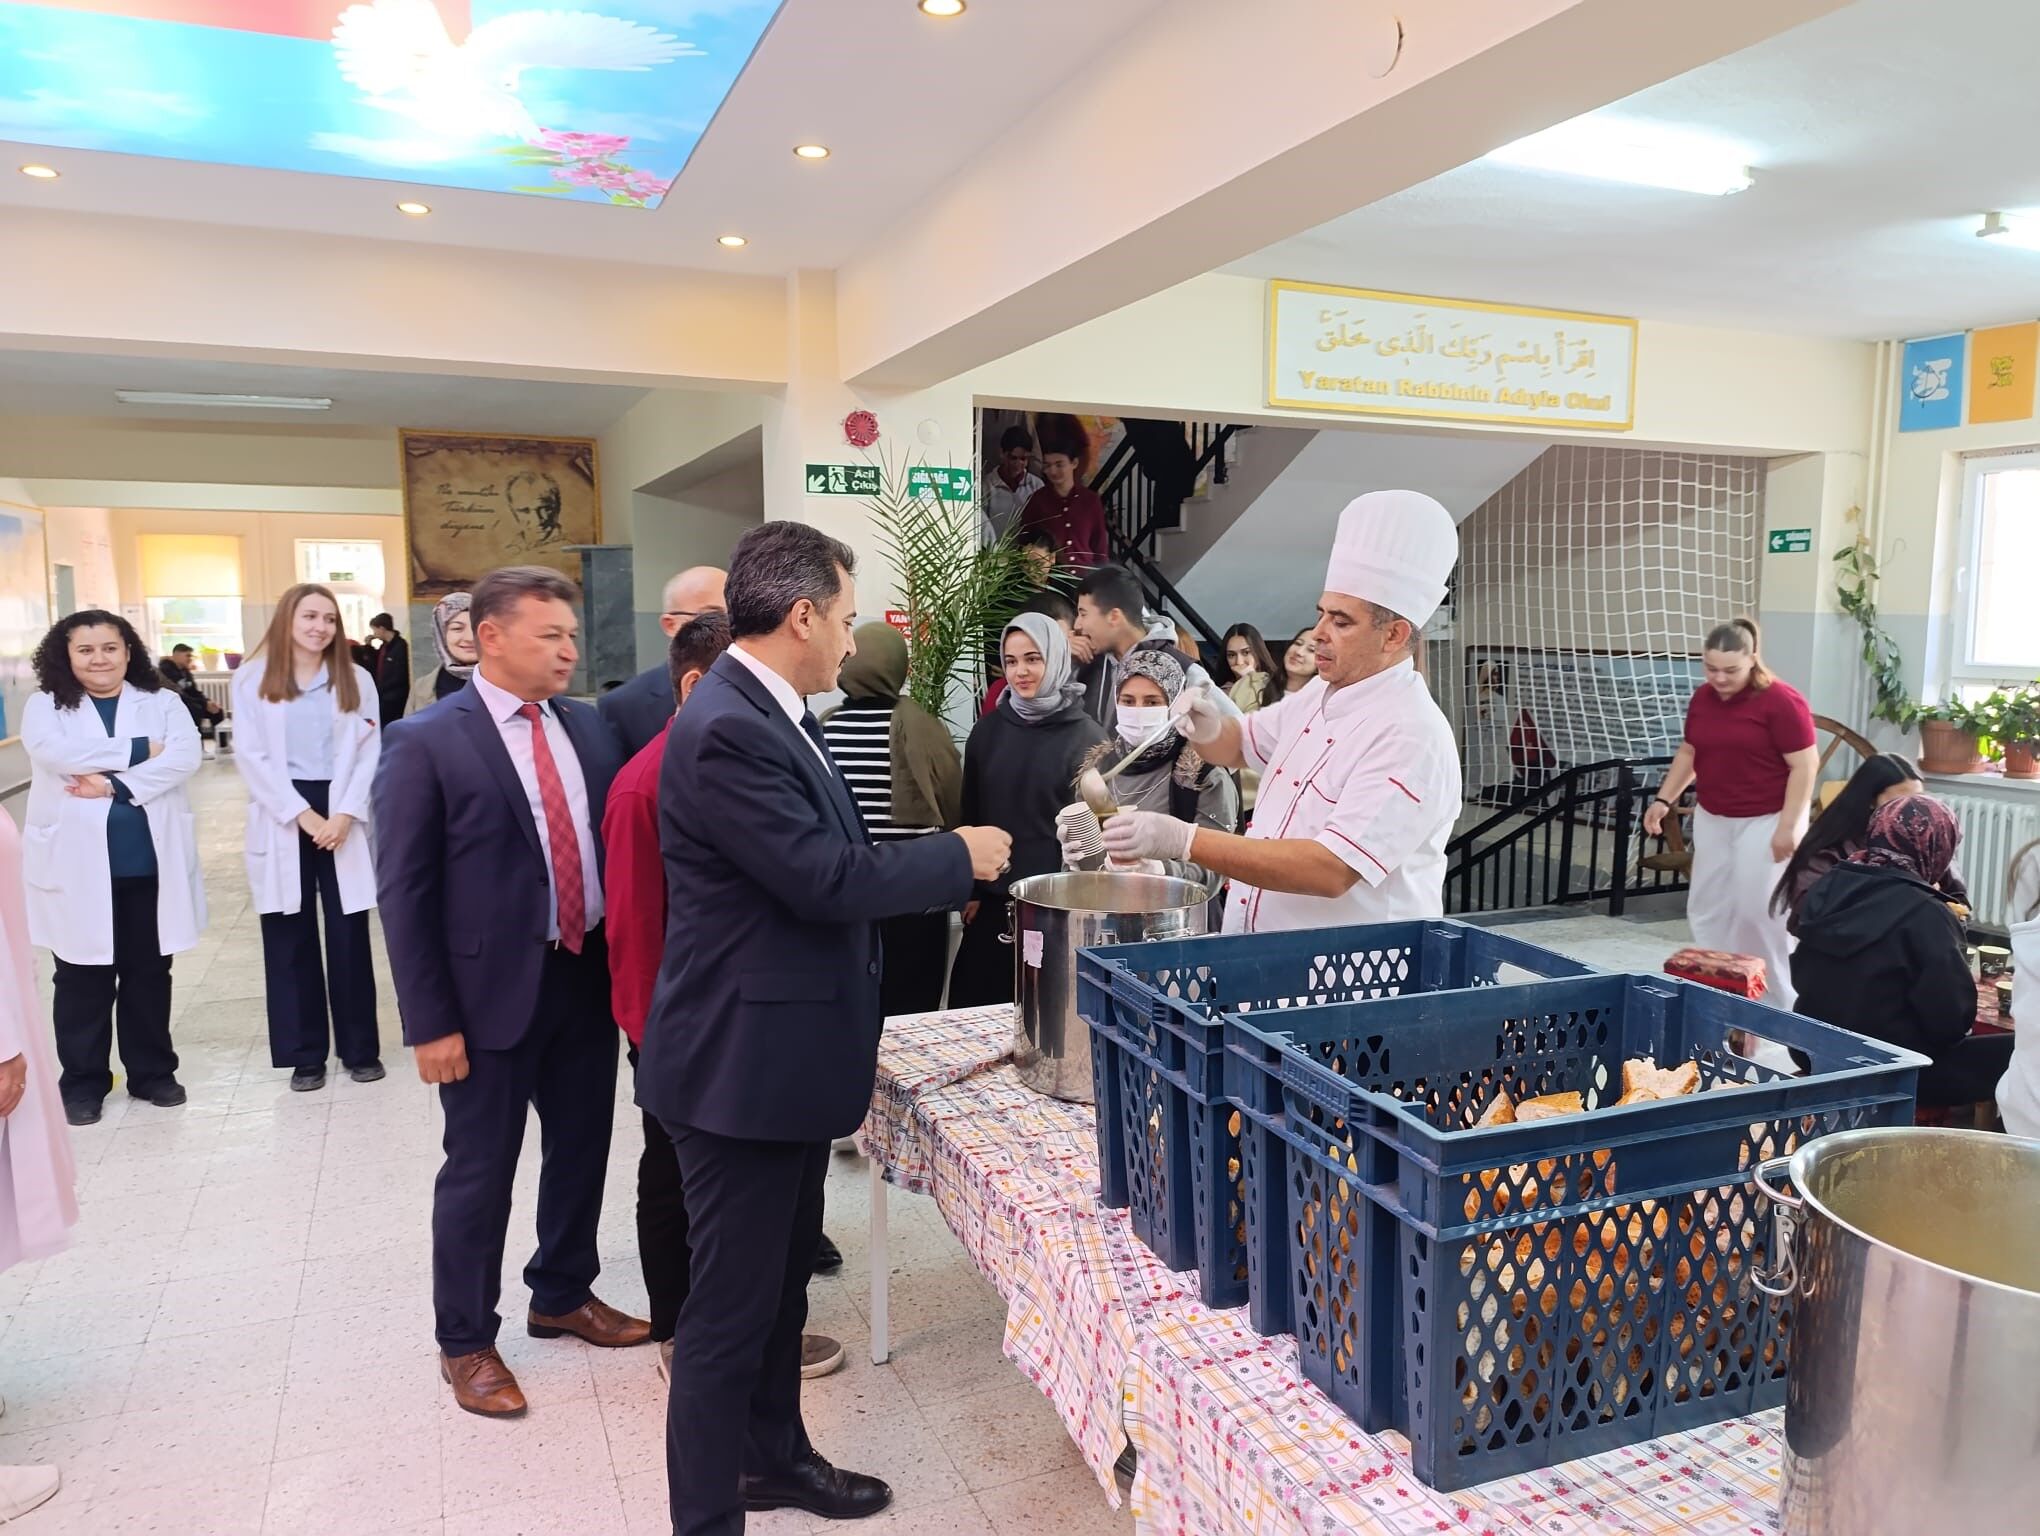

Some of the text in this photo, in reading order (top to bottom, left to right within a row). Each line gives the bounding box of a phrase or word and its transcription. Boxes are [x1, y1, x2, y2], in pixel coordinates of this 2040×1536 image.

[1297, 369, 1390, 395] Yaratan
[854, 469, 875, 479] Acil
[851, 480, 878, 491] Çıkış
